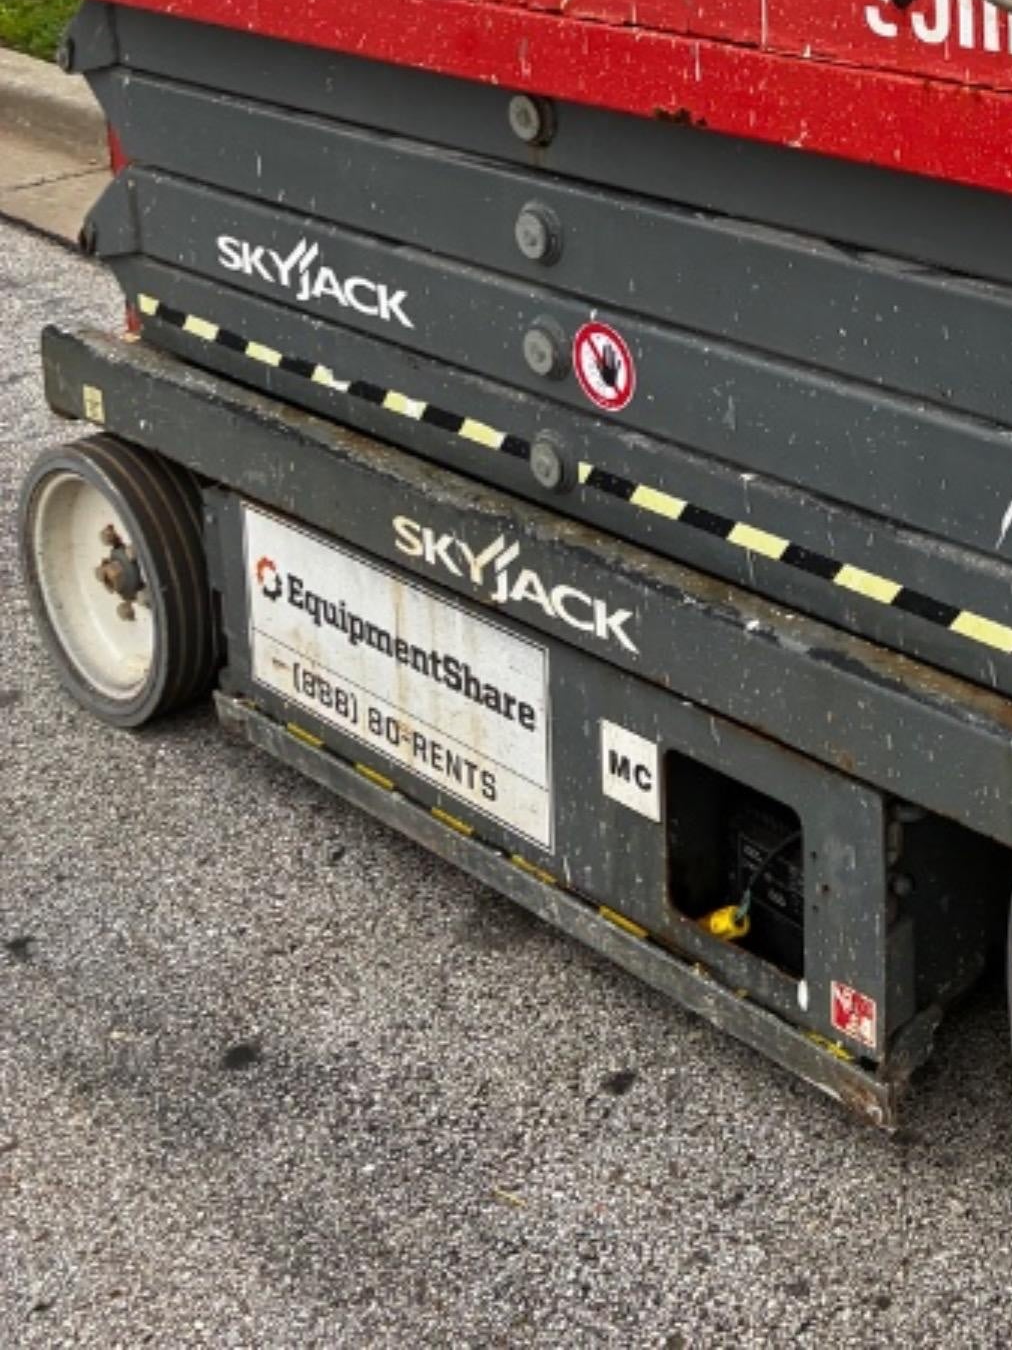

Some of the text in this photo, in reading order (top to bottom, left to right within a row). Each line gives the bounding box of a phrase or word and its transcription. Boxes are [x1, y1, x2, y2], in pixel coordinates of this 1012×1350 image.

[216, 235, 416, 329] SKYJACK
[391, 514, 640, 654] SKYJACK
[286, 573, 536, 732] EquipmentShare
[292, 662, 358, 725] (888)
[607, 749, 653, 793] MC
